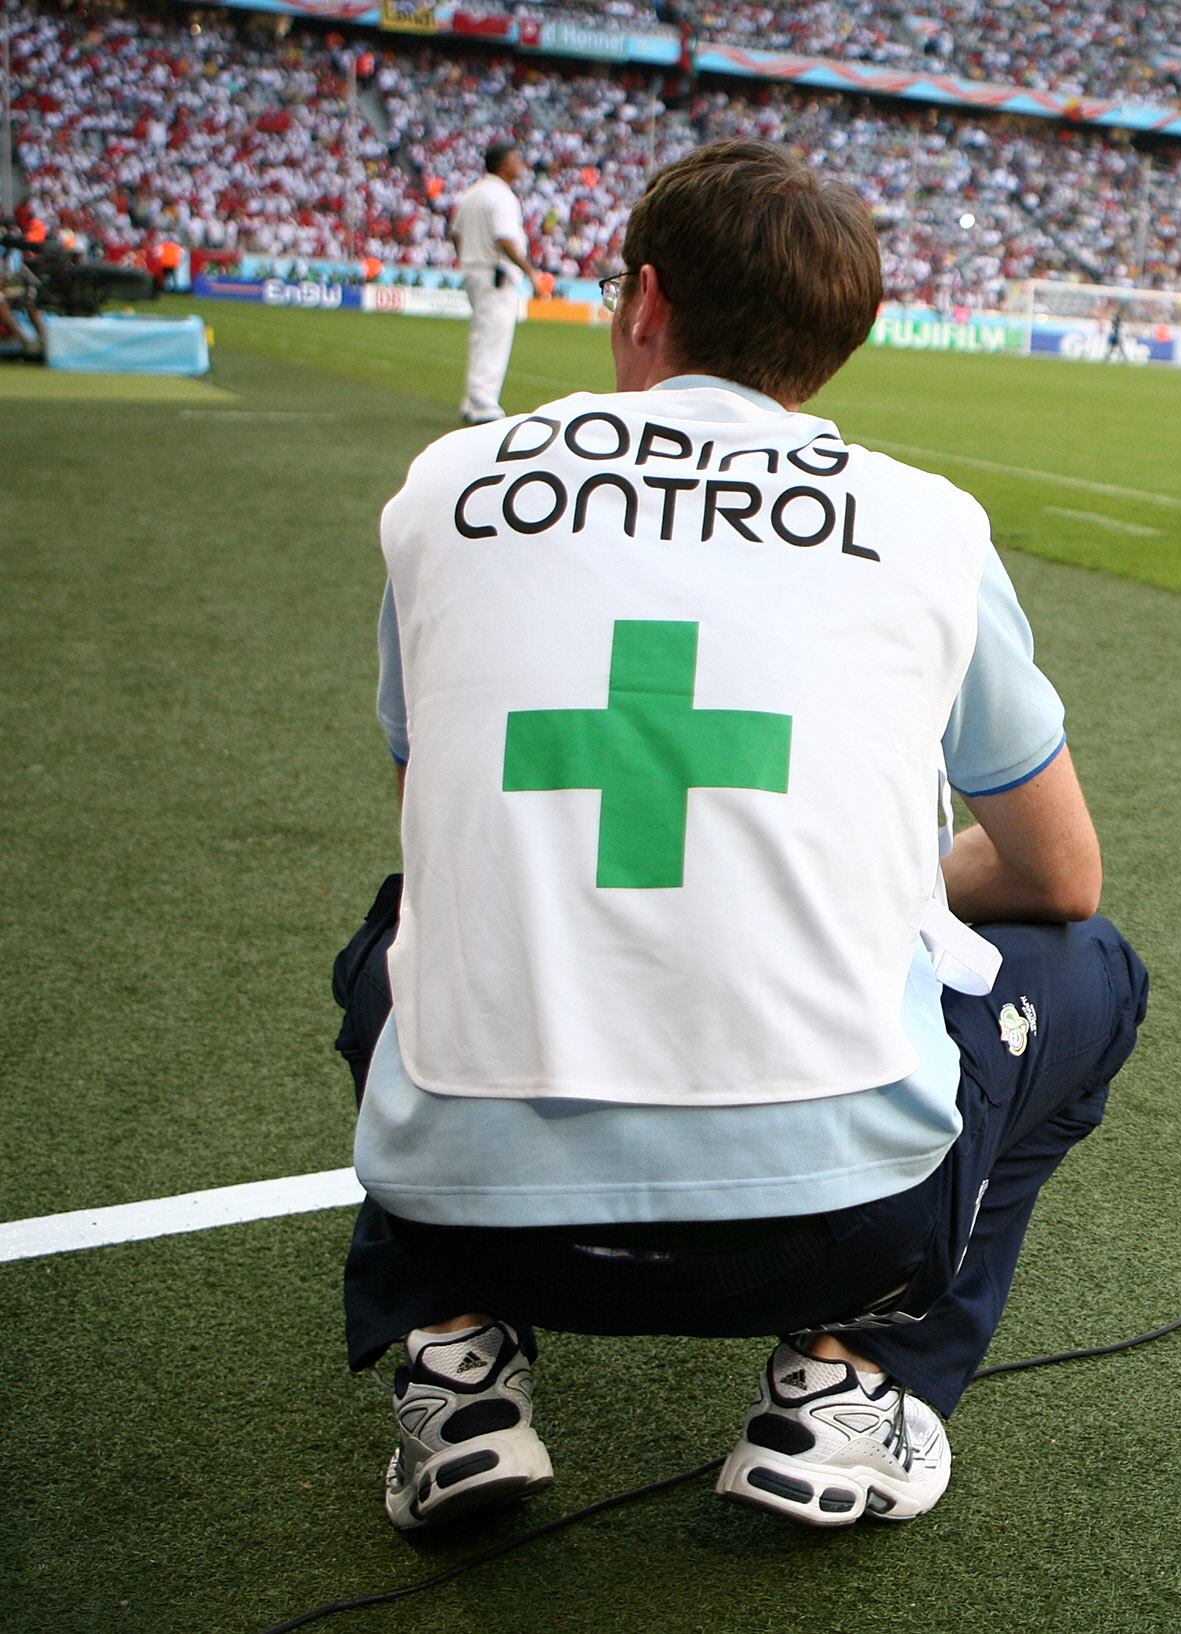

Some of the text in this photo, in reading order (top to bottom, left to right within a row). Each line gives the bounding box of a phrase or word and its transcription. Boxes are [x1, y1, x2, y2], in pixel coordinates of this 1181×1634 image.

[876, 318, 1006, 352] FUJIFILM
[496, 411, 849, 476] DOPING
[454, 470, 881, 562] CONTROL
